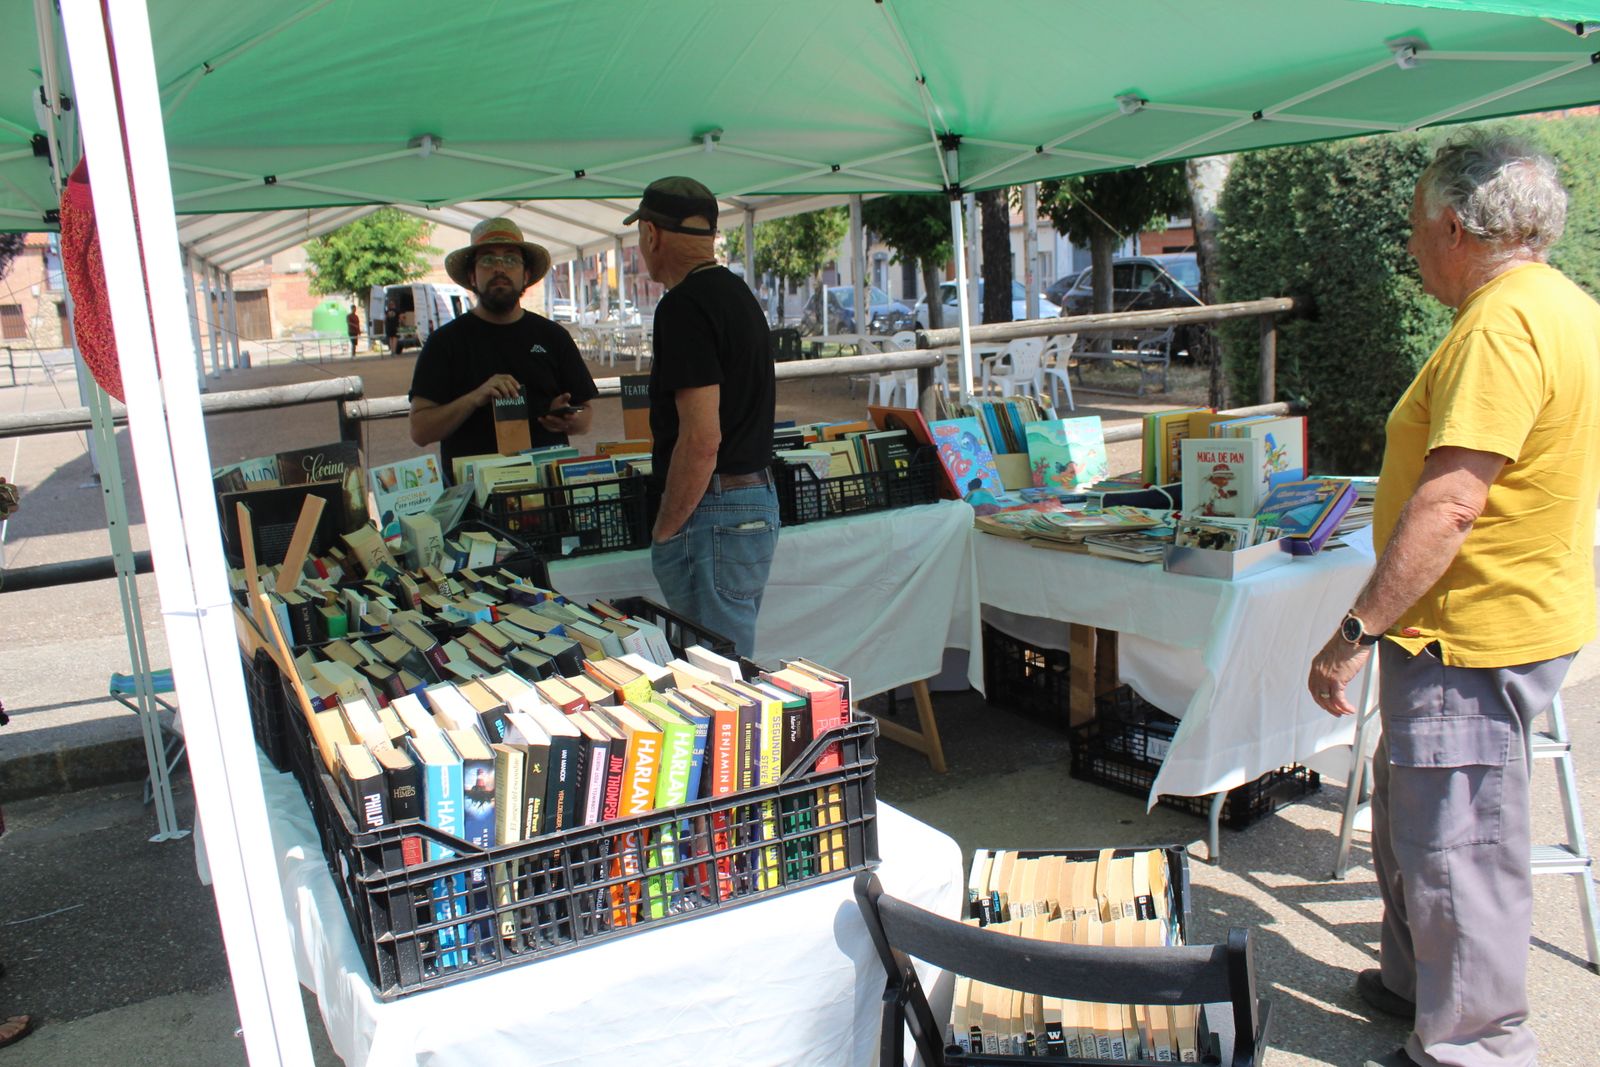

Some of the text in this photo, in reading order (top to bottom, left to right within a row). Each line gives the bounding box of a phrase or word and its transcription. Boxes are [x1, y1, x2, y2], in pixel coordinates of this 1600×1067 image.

[245, 459, 277, 481] AUDÍ
[302, 453, 344, 482] Cocina
[1196, 451, 1244, 464] MIGA DE PAN
[720, 723, 732, 783] BENJAMIN
[771, 716, 781, 763] SEGUNDA
[559, 759, 567, 782] MANOOK
[608, 754, 622, 772] JIM
[630, 738, 656, 814] HARLAN
[666, 732, 692, 805] HARLAN
[761, 755, 769, 779] STEVE
[363, 793, 385, 827] PHILIP
[531, 797, 541, 833] Alan Furst
[603, 775, 620, 822] THOMPSO
